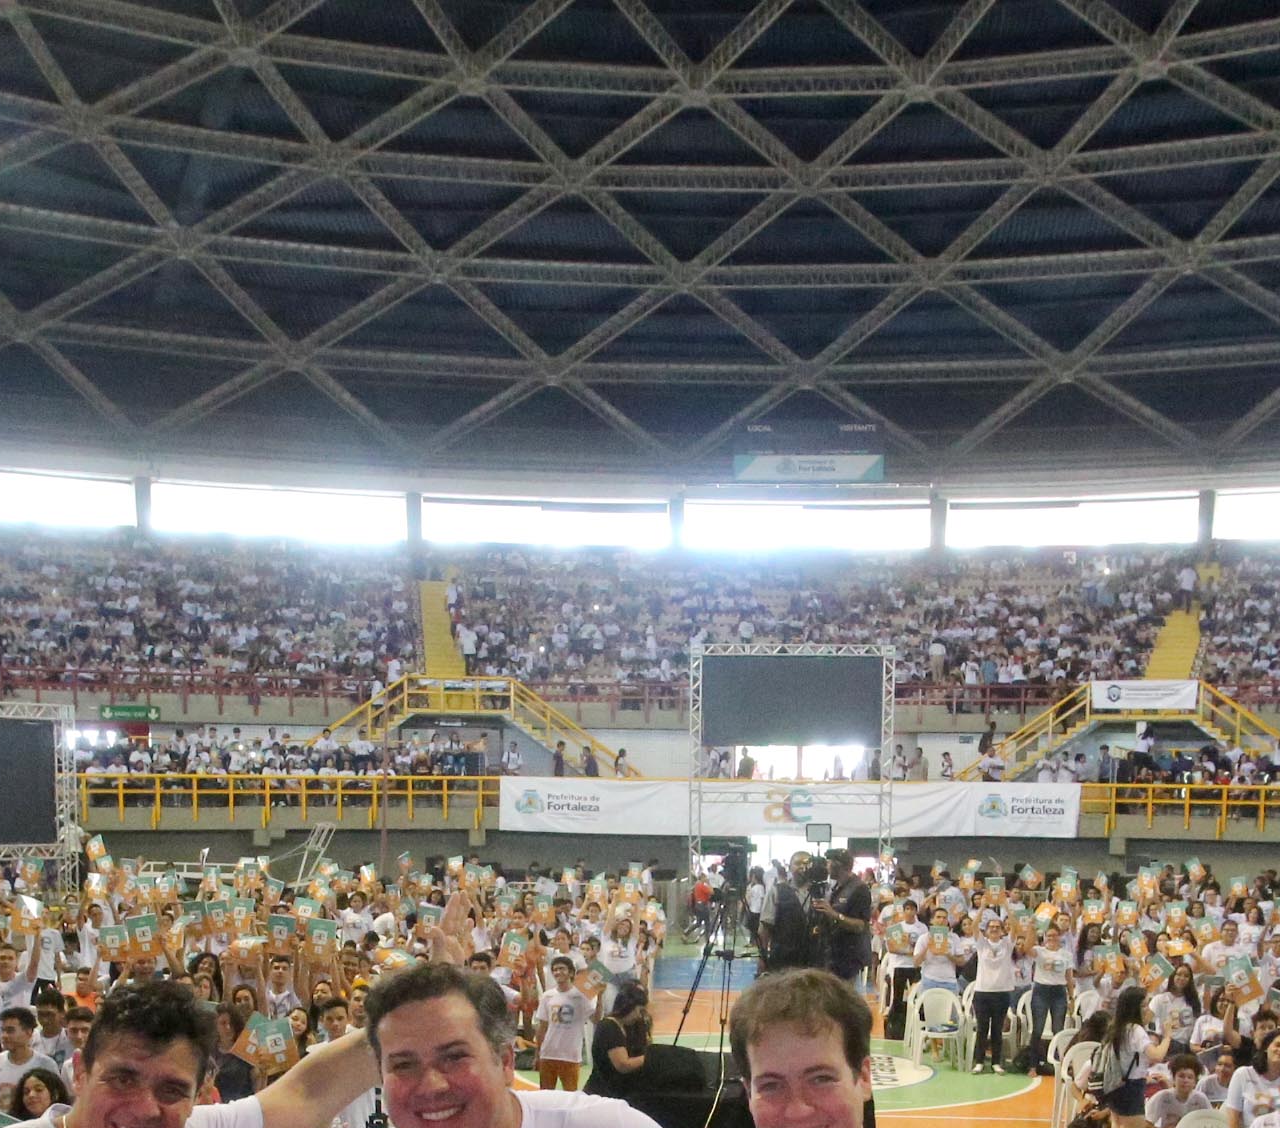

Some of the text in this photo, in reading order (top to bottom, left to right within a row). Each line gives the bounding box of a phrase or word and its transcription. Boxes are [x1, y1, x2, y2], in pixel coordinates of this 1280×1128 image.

[547, 793, 588, 801] Prefeitura
[1011, 796, 1053, 804] Prefeitura
[547, 801, 600, 812] Fortaleza
[1011, 805, 1065, 815] Fortaleza
